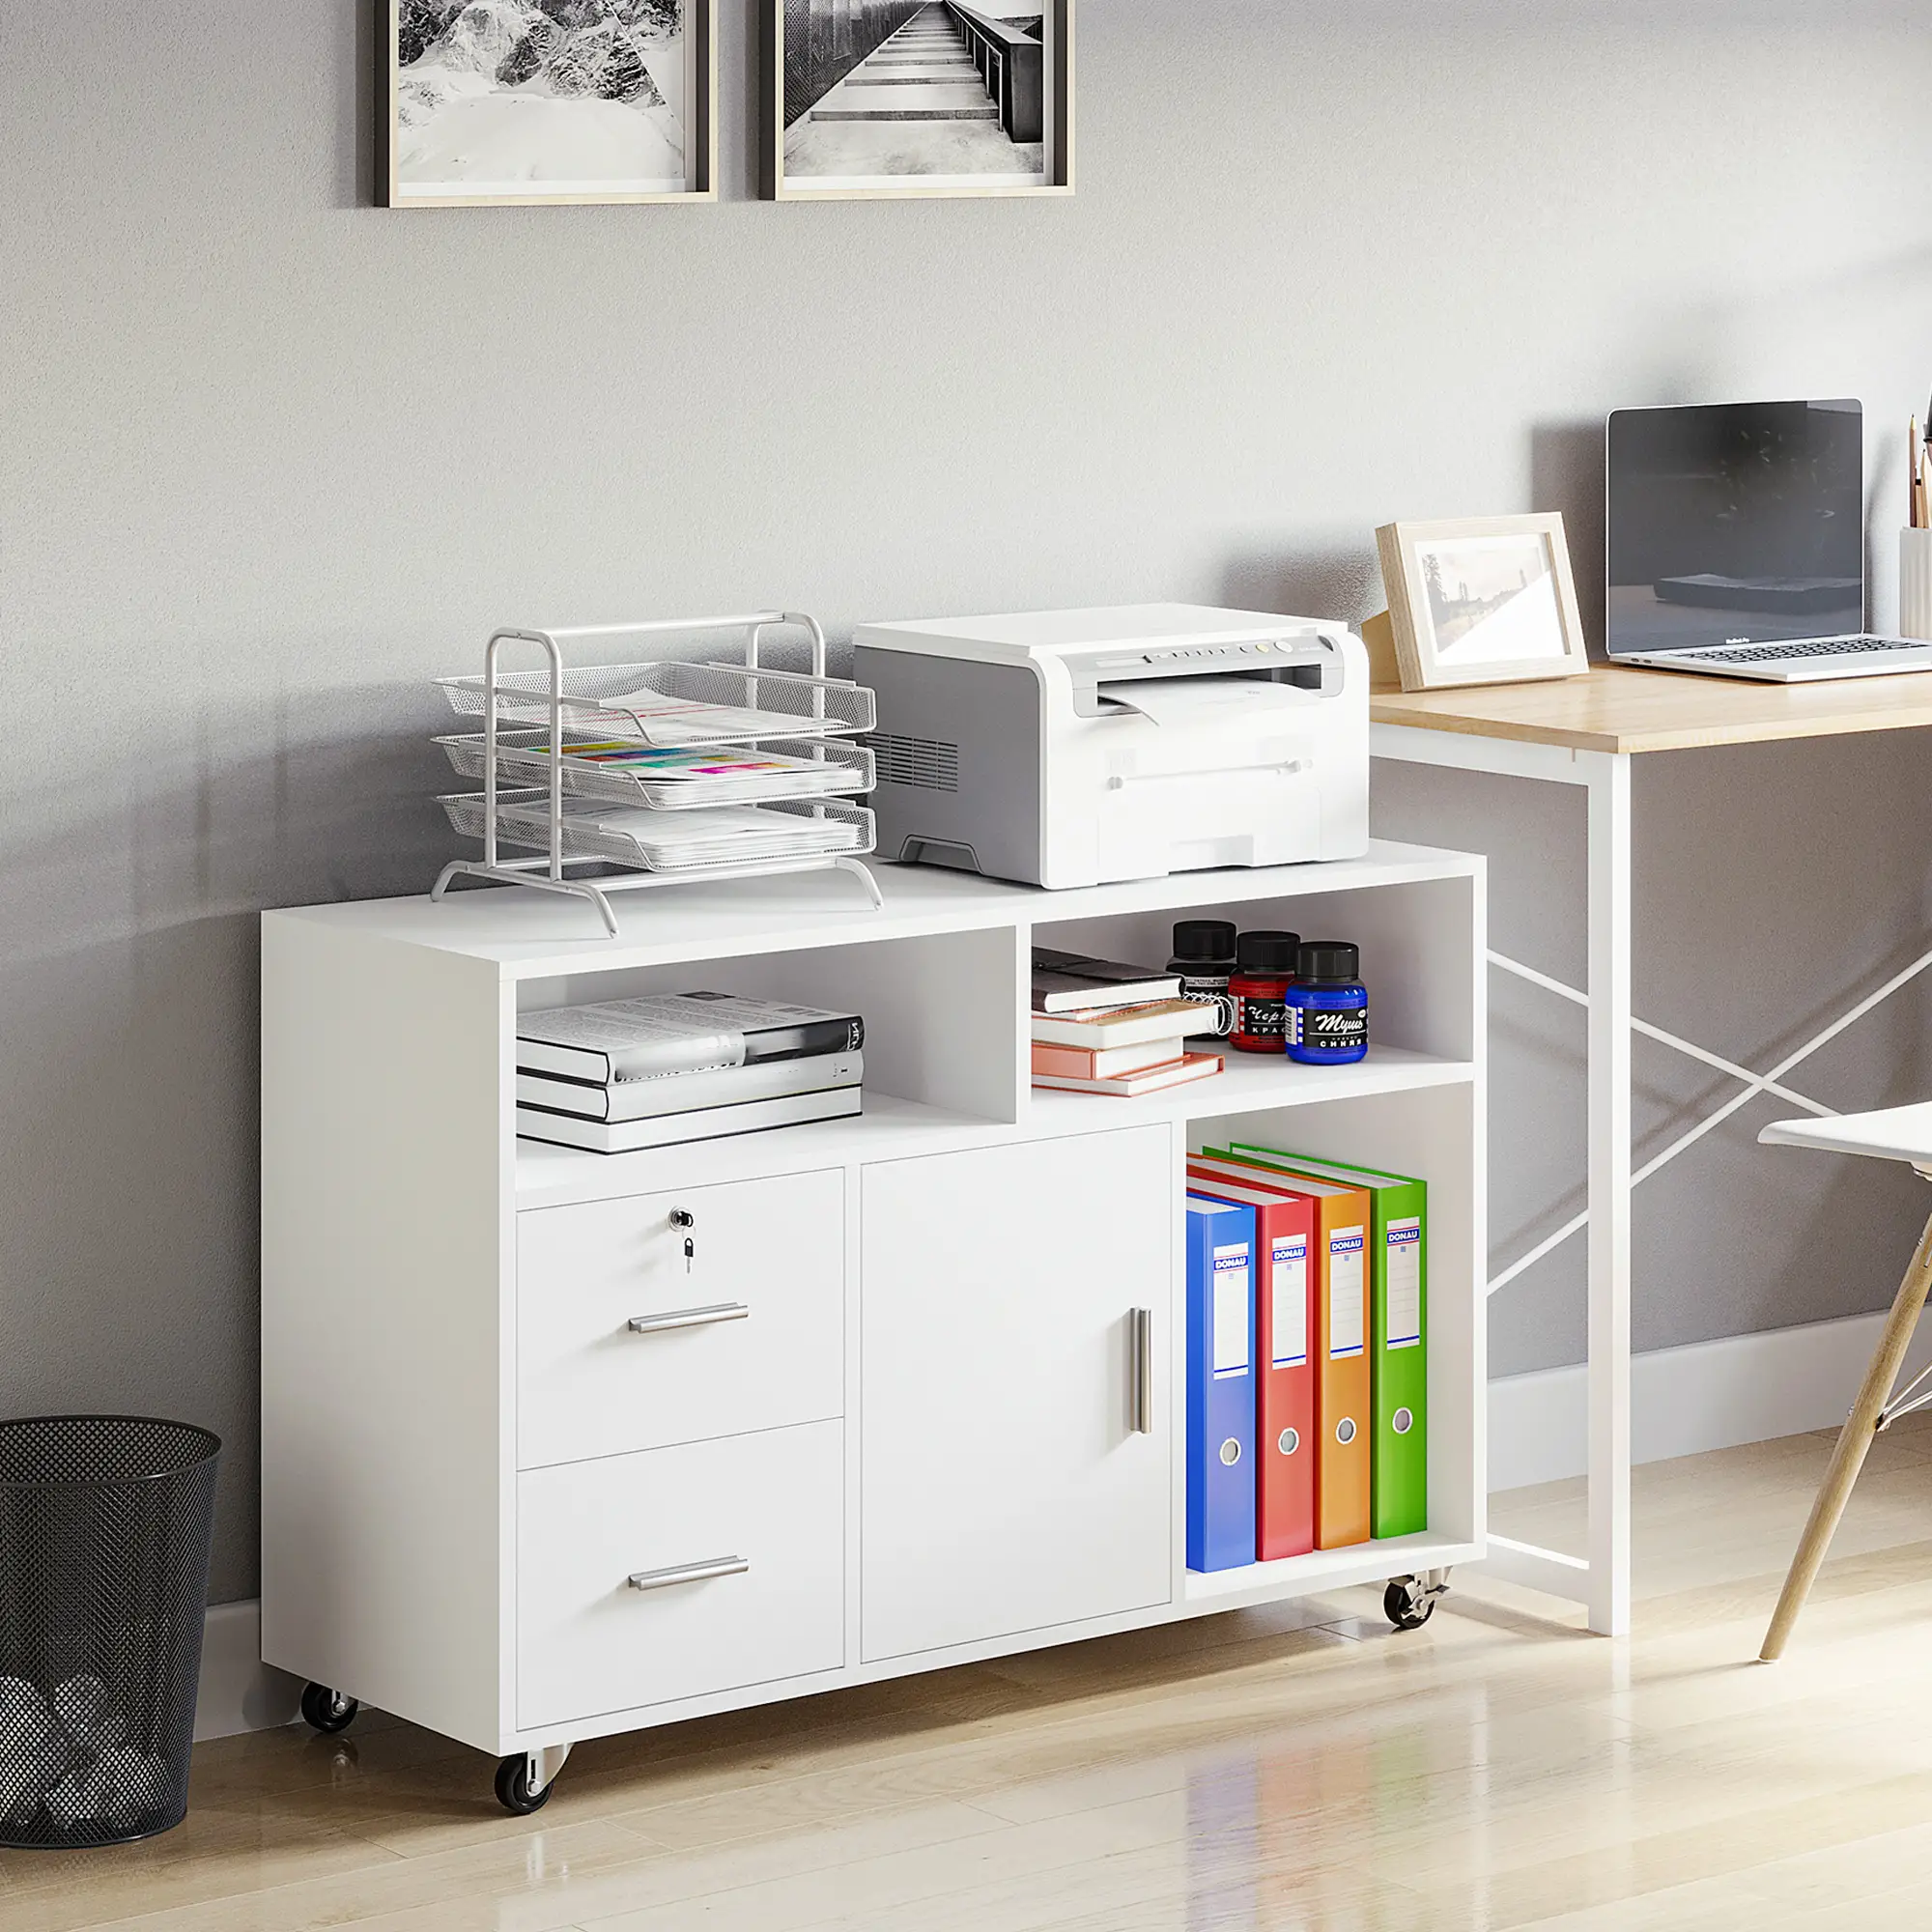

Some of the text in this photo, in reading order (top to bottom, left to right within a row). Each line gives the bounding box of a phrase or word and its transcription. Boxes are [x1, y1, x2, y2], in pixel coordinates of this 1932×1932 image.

[1388, 1230, 1418, 1242] DONAU
[1331, 1239, 1361, 1251] DONAU
[1273, 1248, 1304, 1260] DONAU
[1215, 1257, 1246, 1269] DONAU
